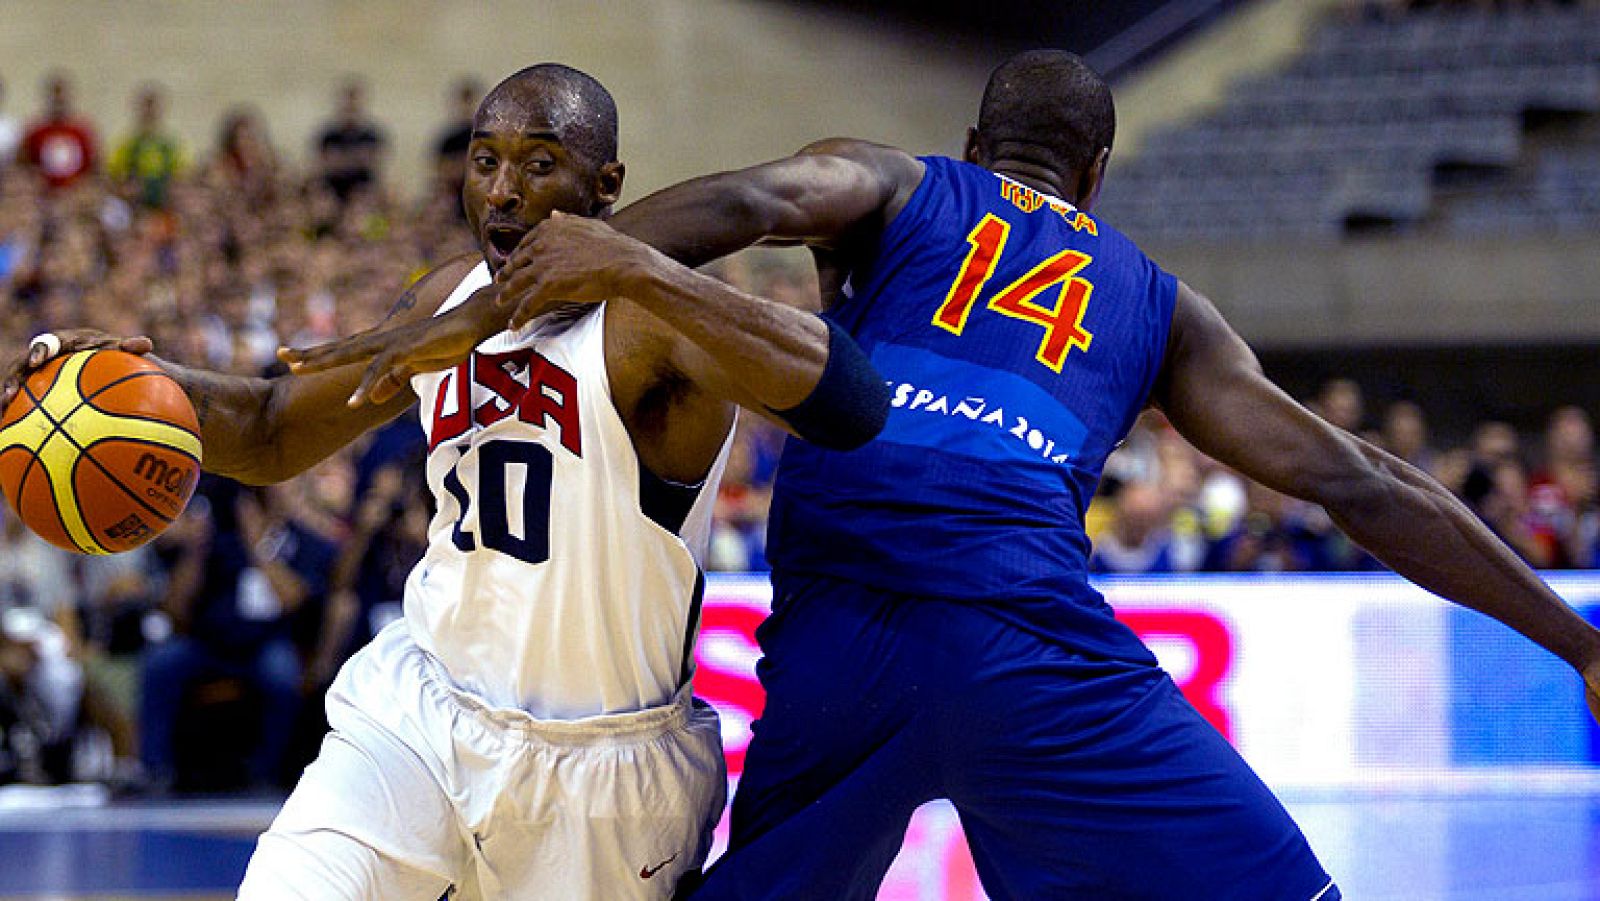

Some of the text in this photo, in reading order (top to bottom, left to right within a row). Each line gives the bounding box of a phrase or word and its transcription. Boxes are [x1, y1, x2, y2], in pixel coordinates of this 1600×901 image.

[931, 212, 1094, 374] 14
[428, 348, 583, 459] USA
[886, 381, 1003, 429] SPAÑA
[443, 439, 553, 564] 10
